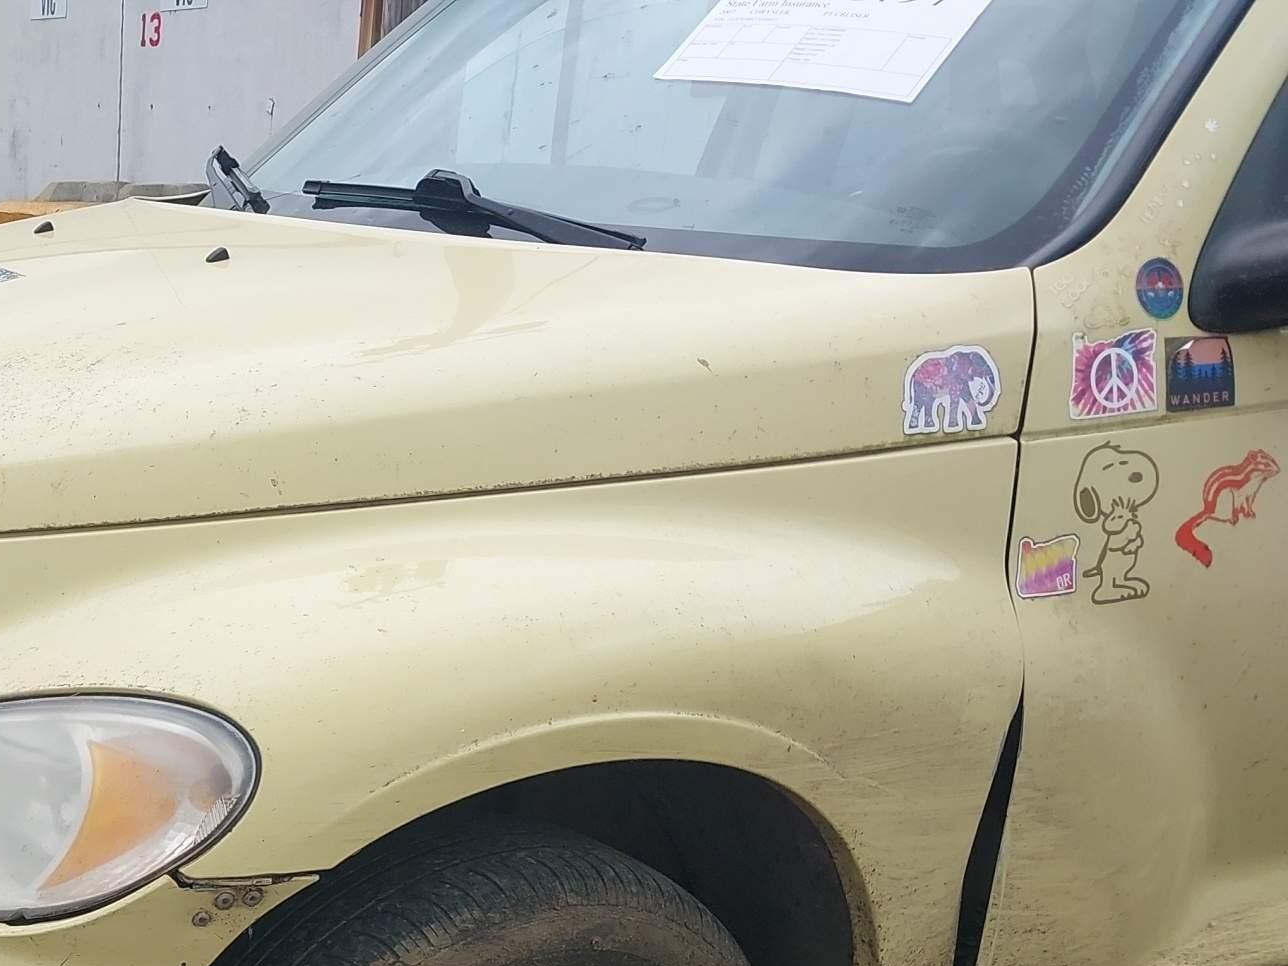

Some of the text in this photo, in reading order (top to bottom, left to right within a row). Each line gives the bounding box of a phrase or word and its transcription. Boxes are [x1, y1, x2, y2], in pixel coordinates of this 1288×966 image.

[752, 0, 779, 8] Farm
[781, 0, 830, 9] Insurance
[141, 13, 162, 47] 13
[1170, 391, 1230, 406] WANDER
[1056, 572, 1072, 590] OR
